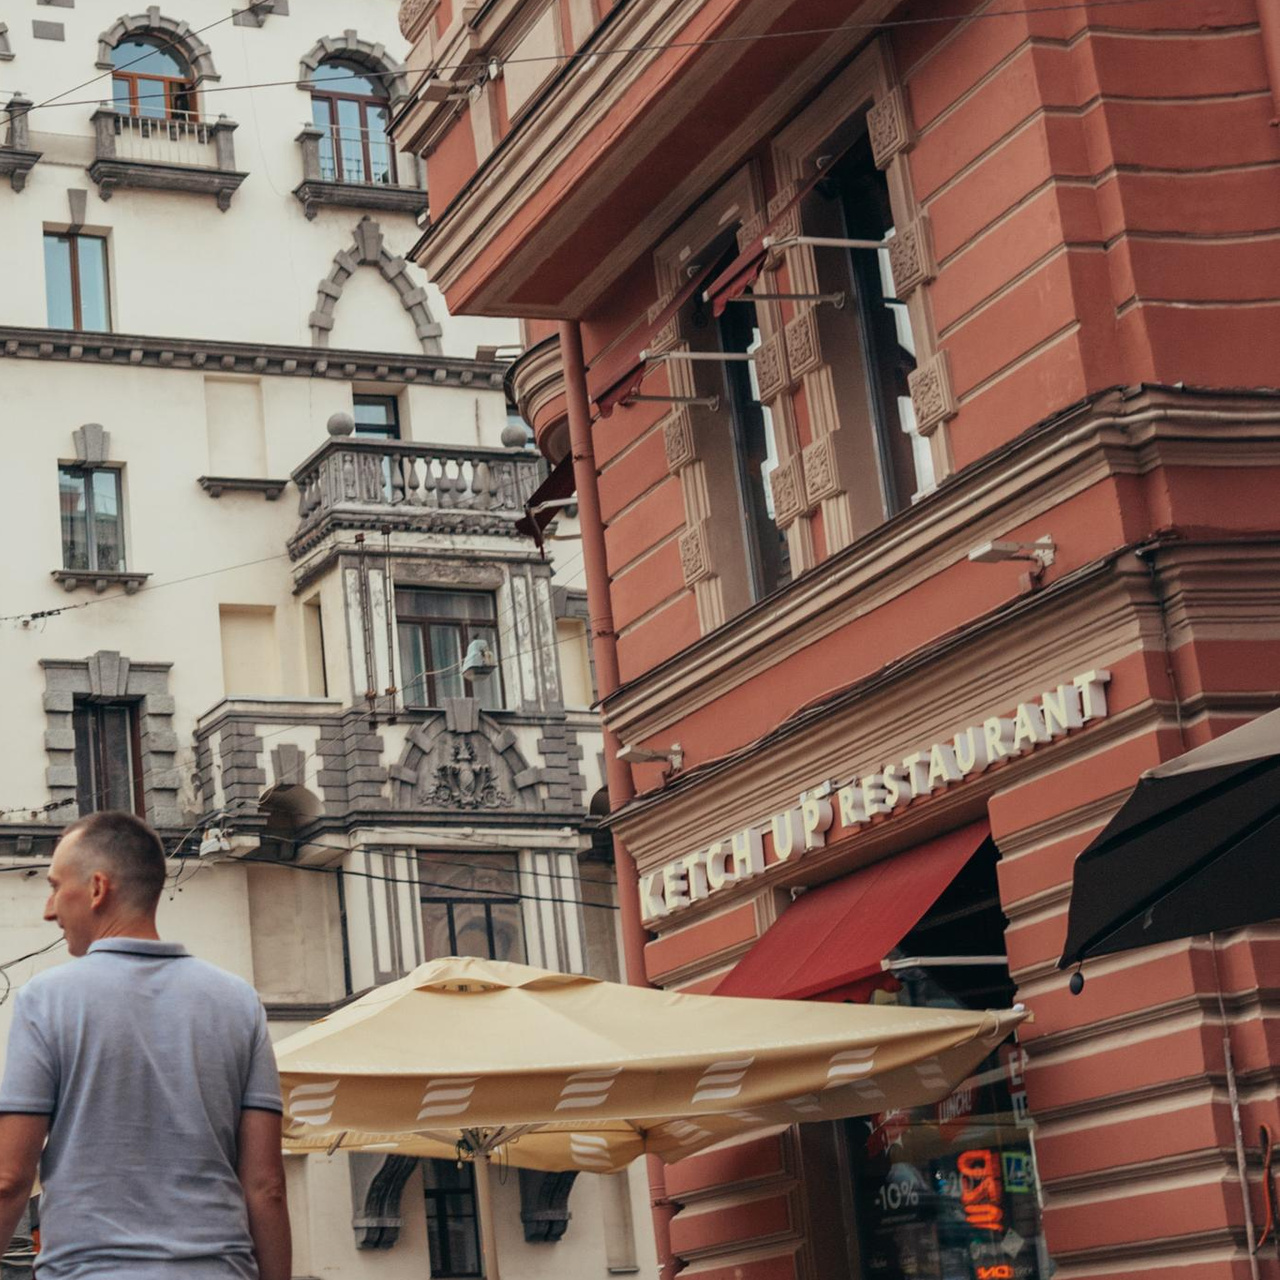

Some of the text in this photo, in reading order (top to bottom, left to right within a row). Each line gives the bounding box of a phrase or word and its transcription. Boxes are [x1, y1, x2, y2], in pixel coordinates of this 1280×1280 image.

[639, 669, 1111, 921] KETCH UP RESTAURANT
[938, 1086, 972, 1124] LUNCH!
